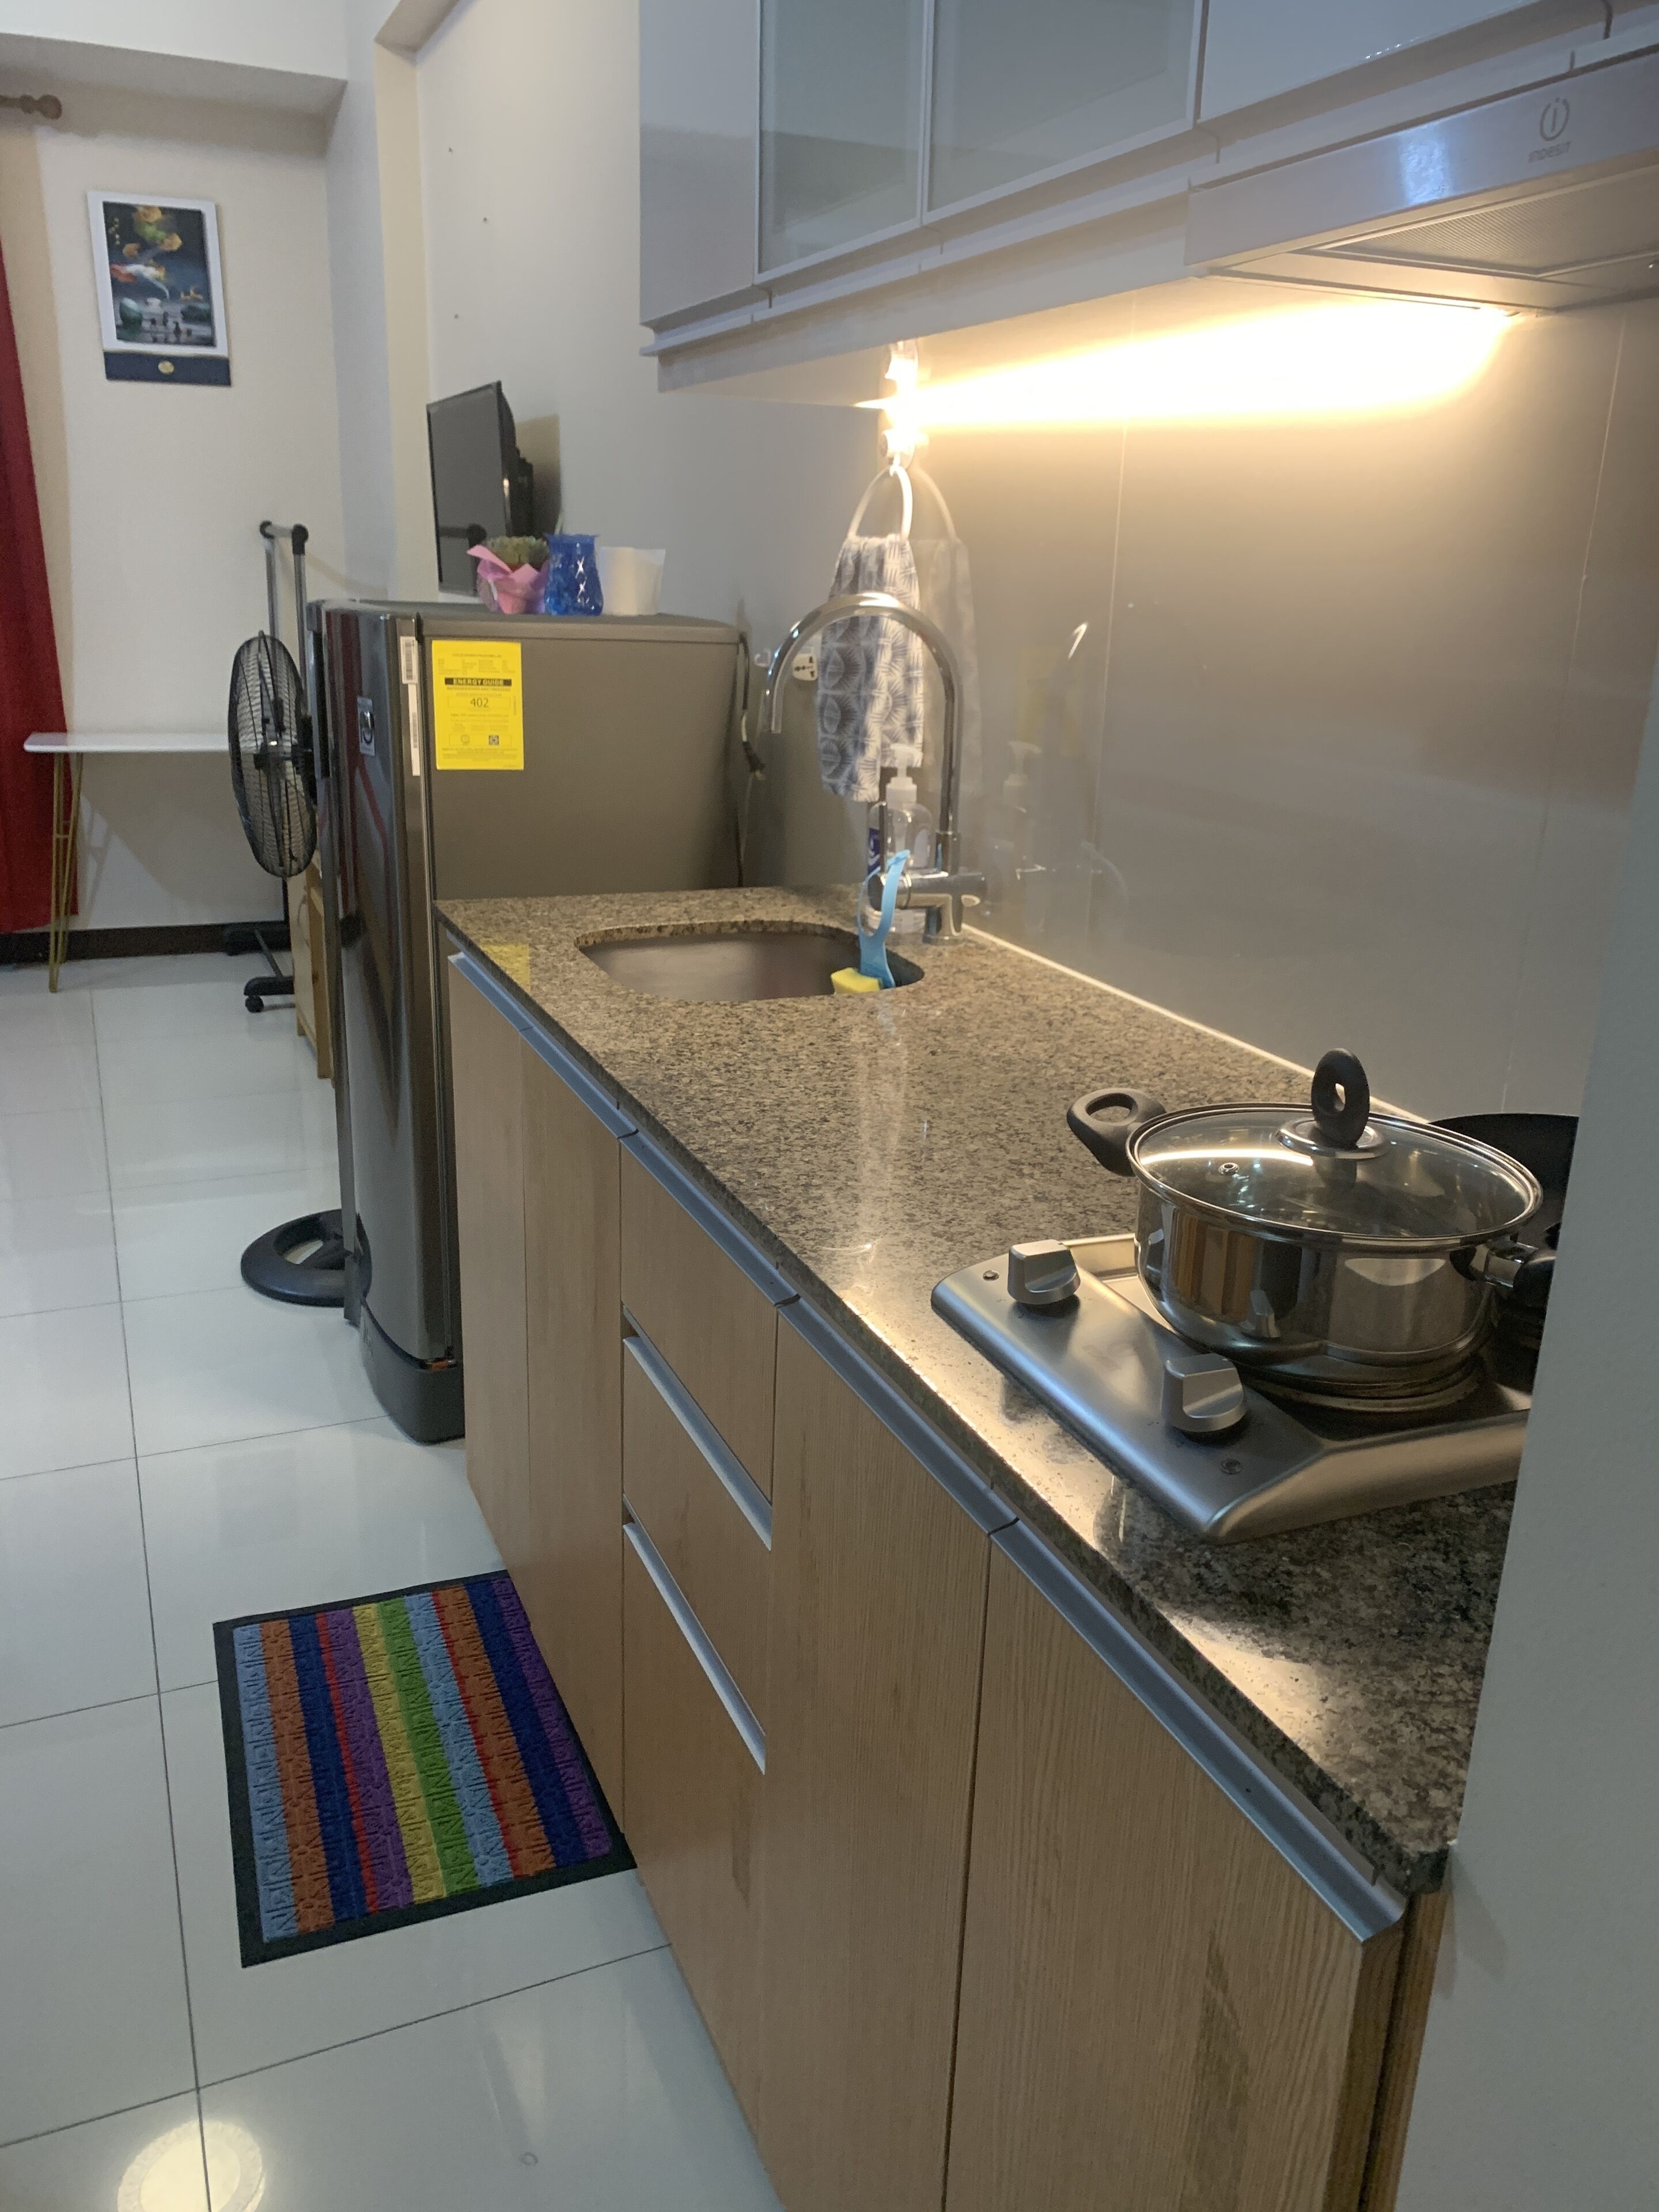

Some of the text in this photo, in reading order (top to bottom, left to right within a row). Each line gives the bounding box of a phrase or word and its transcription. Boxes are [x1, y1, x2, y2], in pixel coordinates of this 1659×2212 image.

[453, 678, 504, 687] ENERGY GUIDE
[470, 697, 489, 708] 402
